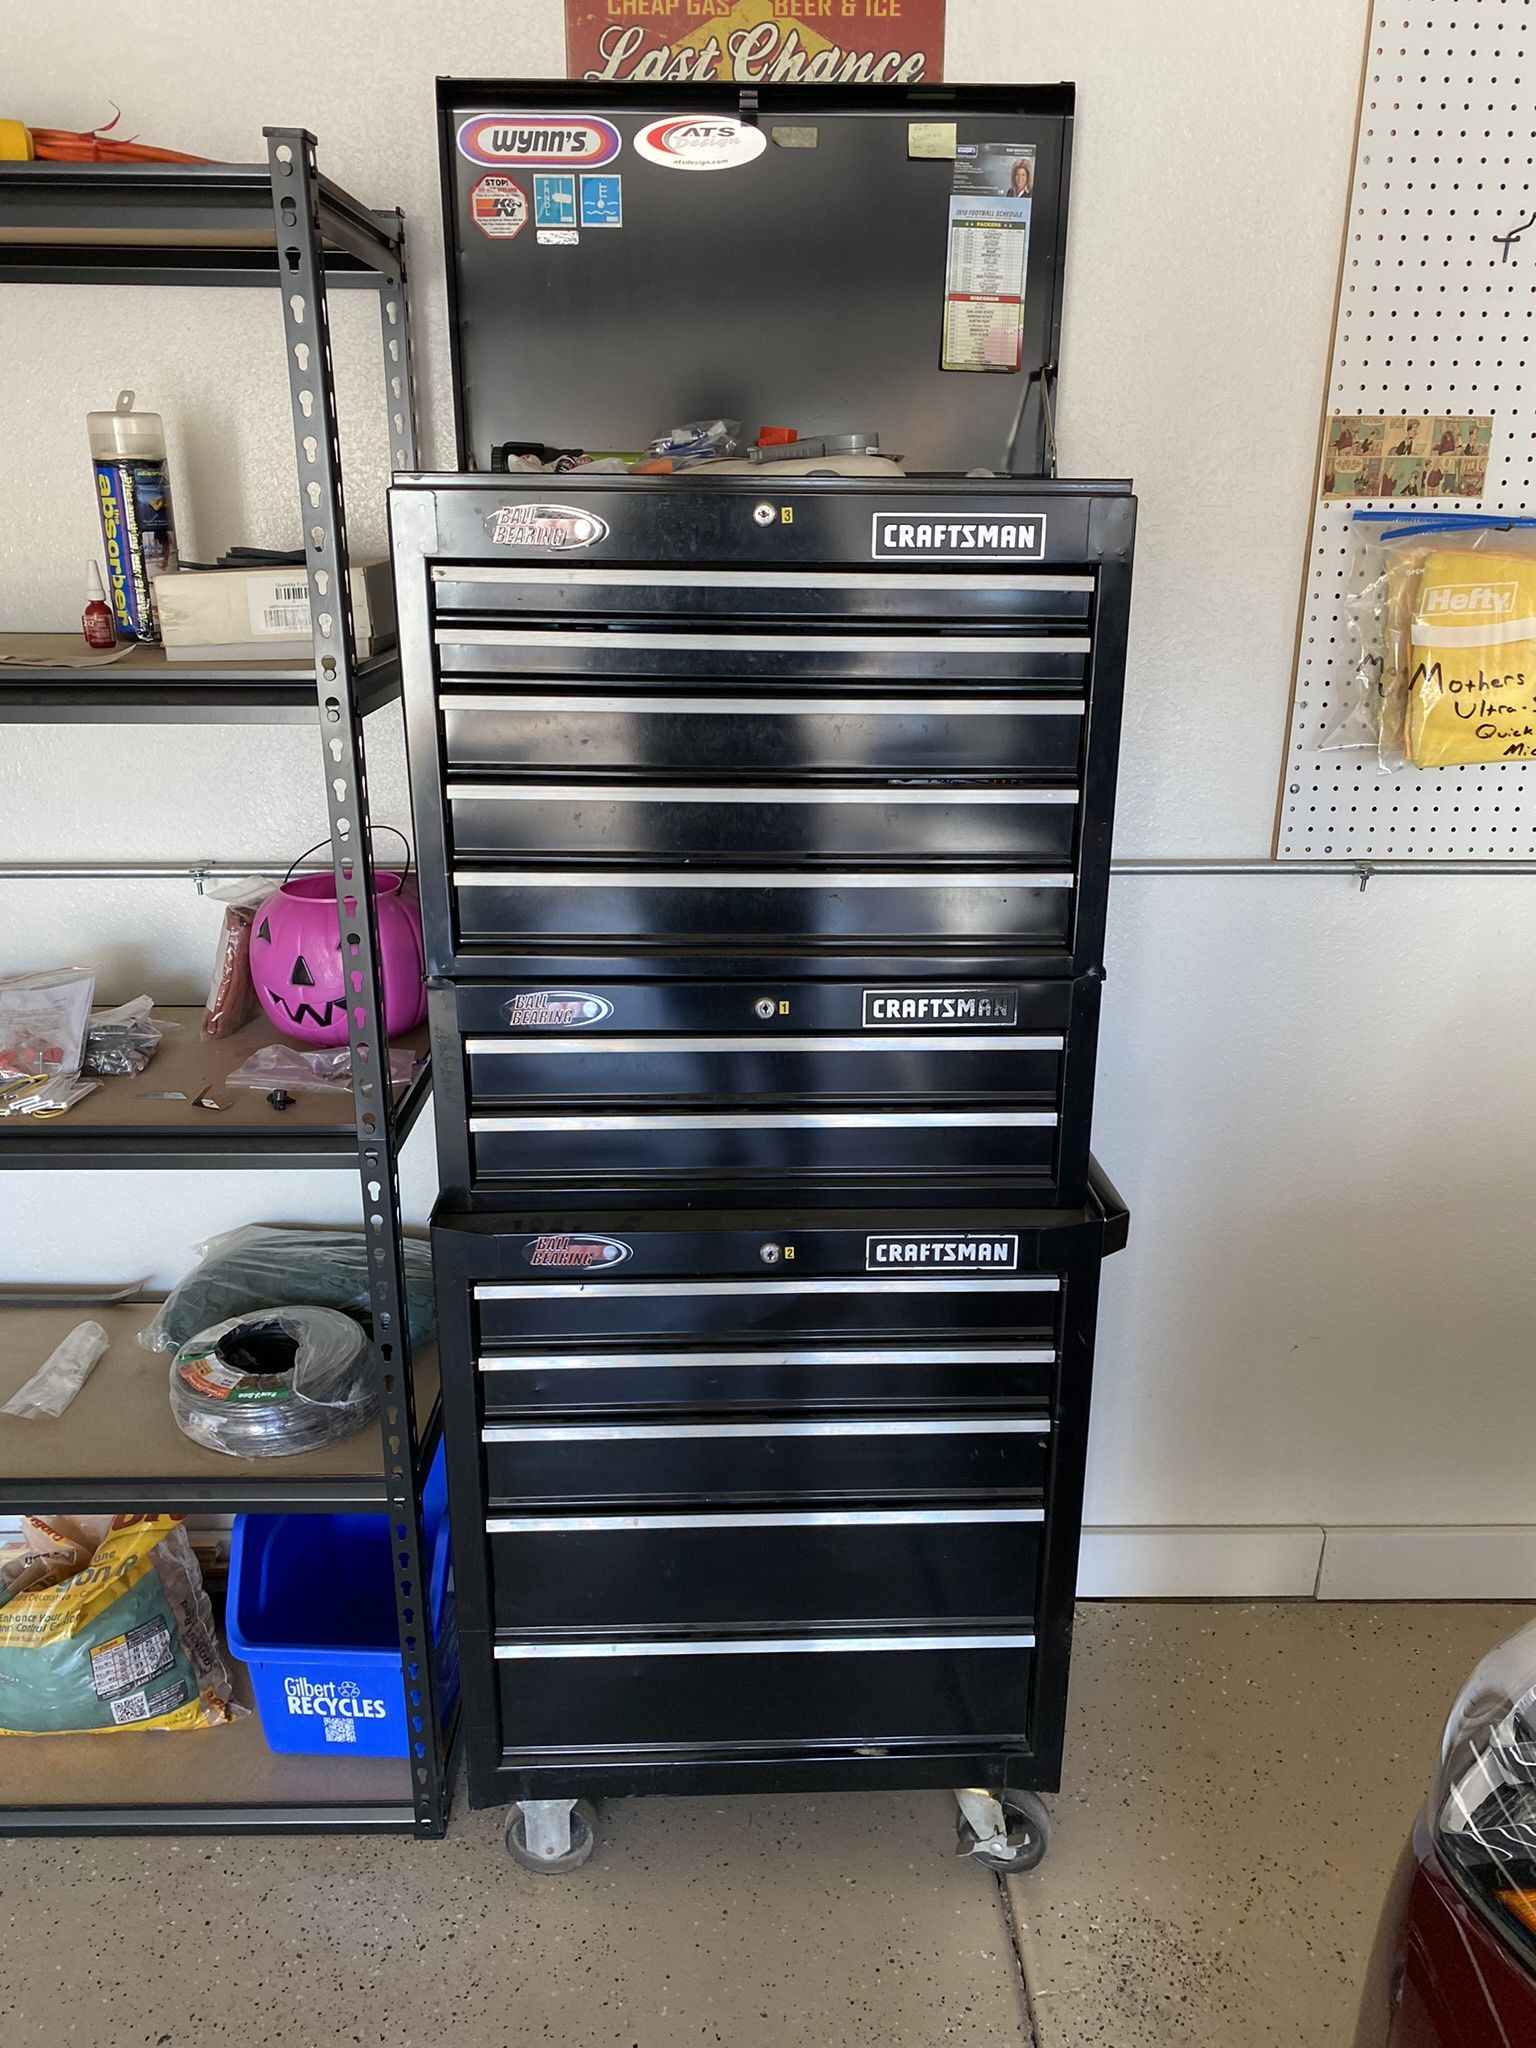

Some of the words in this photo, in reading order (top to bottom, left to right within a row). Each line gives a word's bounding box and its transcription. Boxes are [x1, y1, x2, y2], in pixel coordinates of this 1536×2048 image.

[607, 0, 680, 16] CHEAP
[687, 0, 732, 16] GAS
[774, 0, 832, 17] BEER
[841, 0, 856, 17] &
[865, 0, 902, 17] ICE
[583, 25, 721, 81] Last
[728, 21, 926, 83] Chance
[681, 127, 736, 137] ATS
[672, 135, 741, 149] Design
[968, 209, 995, 217] FOOTBALL
[995, 210, 1023, 218] SCHEDULE
[500, 506, 537, 525] BALL
[783, 509, 791, 522] 3
[493, 526, 567, 546] BEARING
[883, 523, 1036, 549] CRAFTSMAN
[97, 473, 130, 627] absorber
[1426, 587, 1512, 613] Hefty
[1407, 661, 1526, 694] Mothers
[1475, 723, 1533, 739] Quick
[514, 993, 549, 1010] BALL
[781, 1002, 789, 1014] 1
[872, 998, 1008, 1019] CRAFTSMAN
[509, 1009, 574, 1026] BEARING
[535, 1235, 570, 1251] BALL
[529, 1250, 593, 1266] BEARING
[786, 1247, 794, 1259] 2
[875, 1243, 1008, 1262] CRAFTSMAN
[0, 1613, 37, 1623] Enhance
[135, 1661, 144, 1669] 33
[136, 1669, 146, 1677] 66
[284, 1676, 336, 1698] Gilbert
[286, 1695, 387, 1719] RECYCLES
